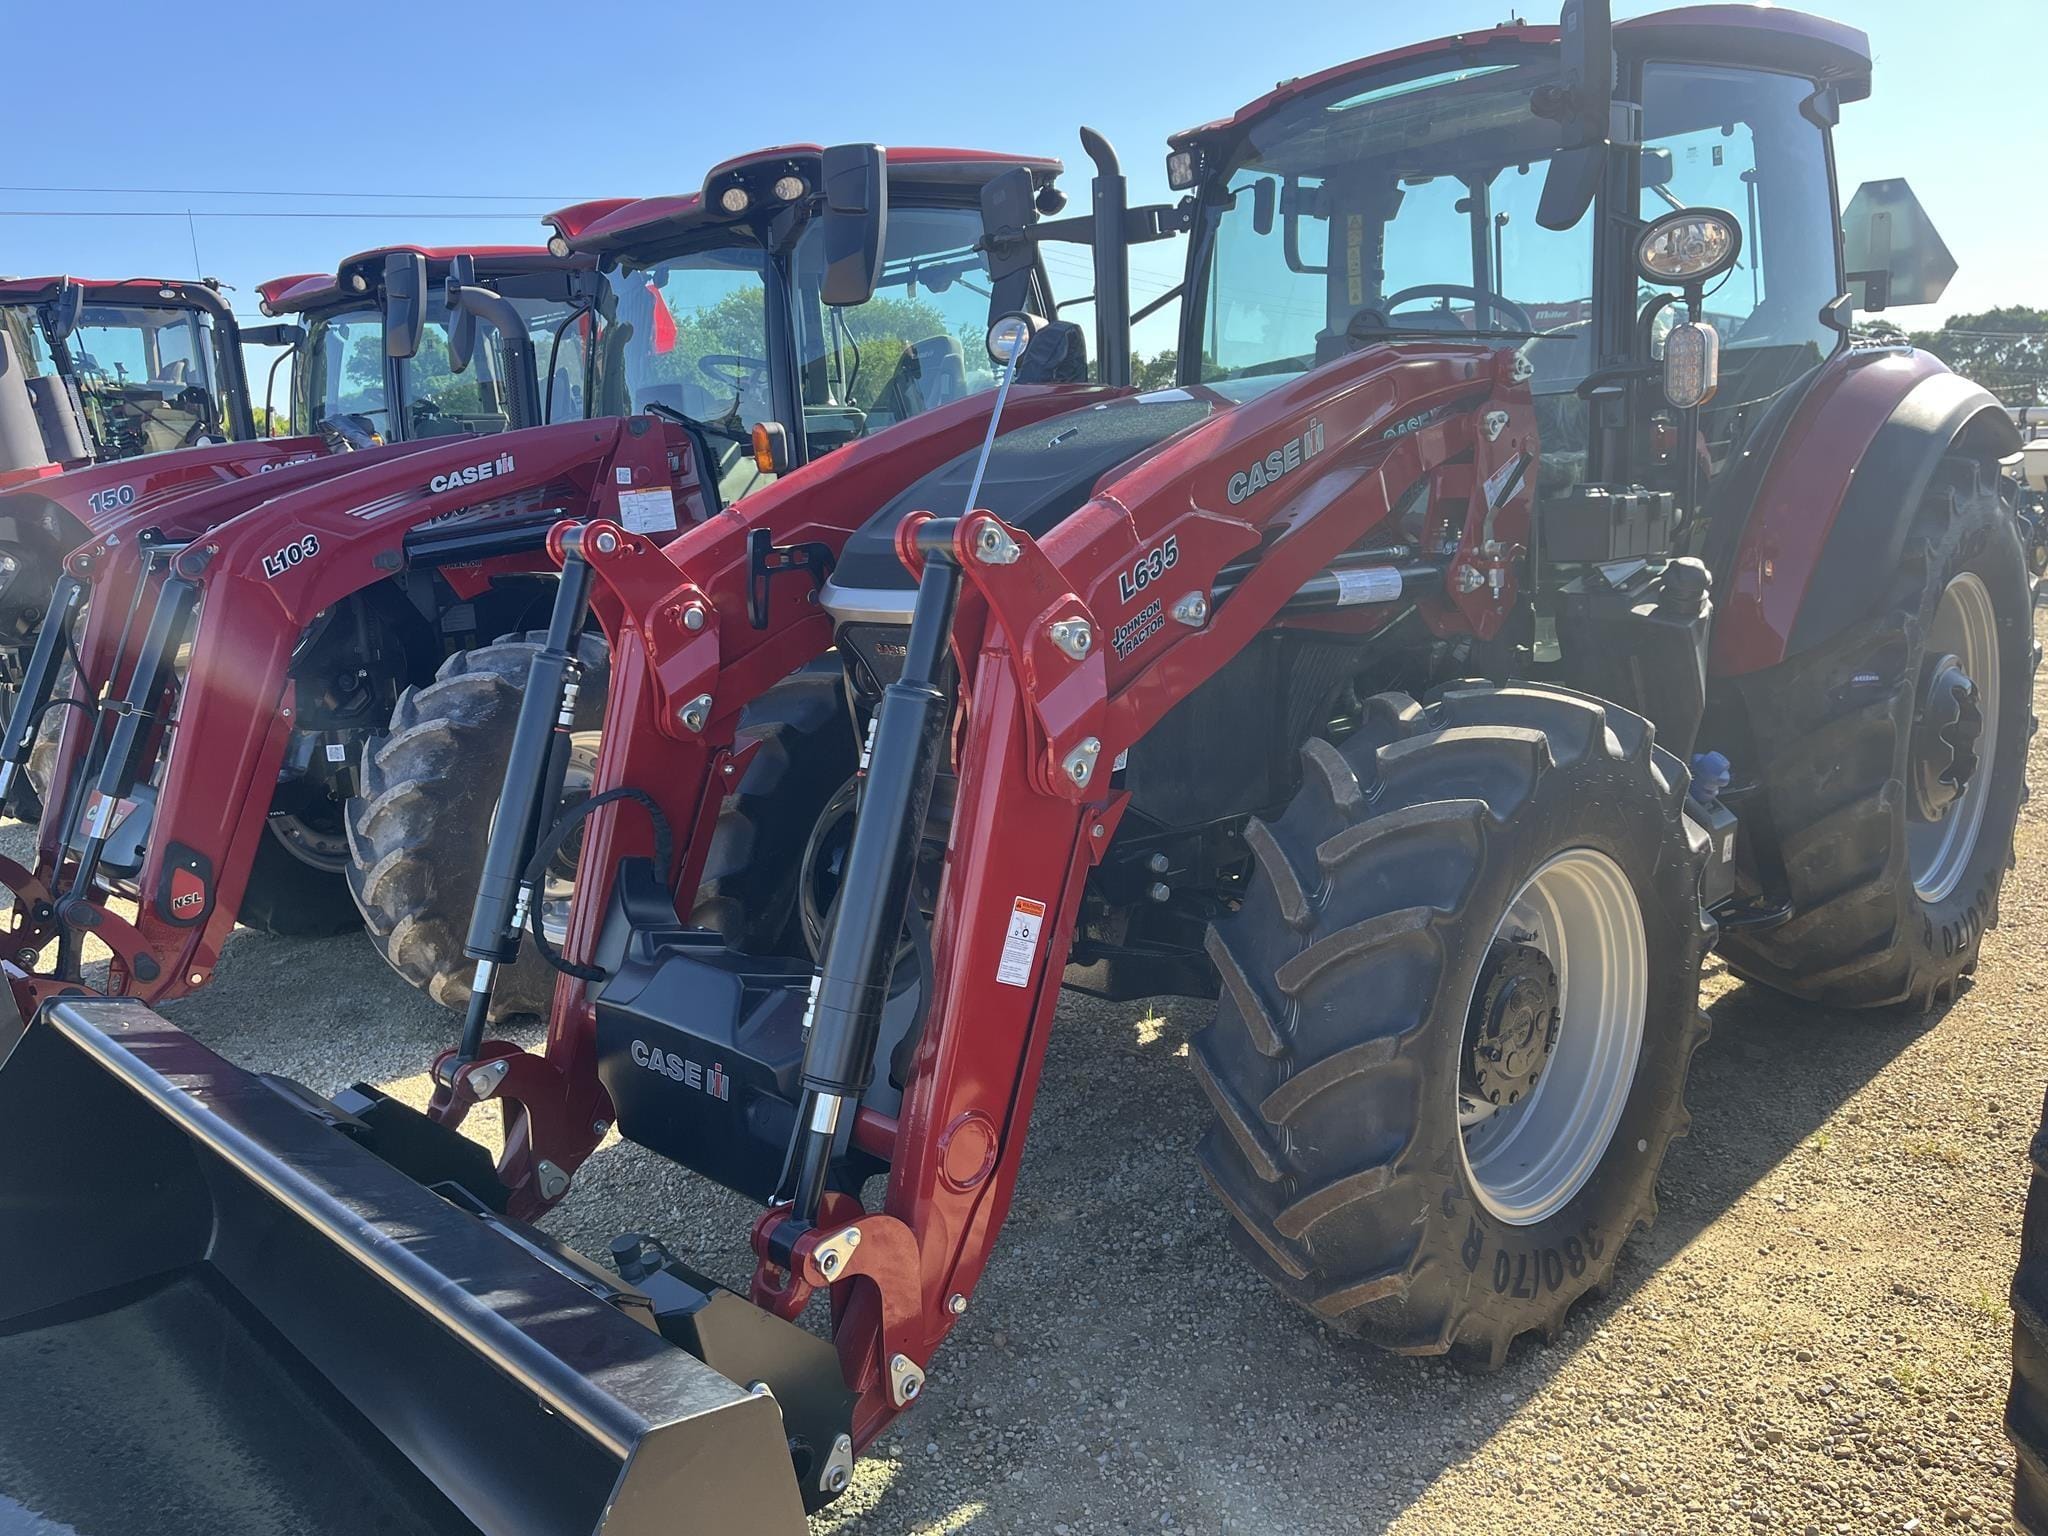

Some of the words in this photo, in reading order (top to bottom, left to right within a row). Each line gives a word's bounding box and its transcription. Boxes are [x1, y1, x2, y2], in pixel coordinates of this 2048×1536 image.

[430, 462, 494, 493] CASE
[1228, 438, 1301, 504] CASE
[88, 485, 135, 514] 150
[262, 534, 319, 579] L103
[1118, 534, 1179, 605] L635
[172, 891, 202, 910] NSL
[631, 1039, 702, 1090] CASE
